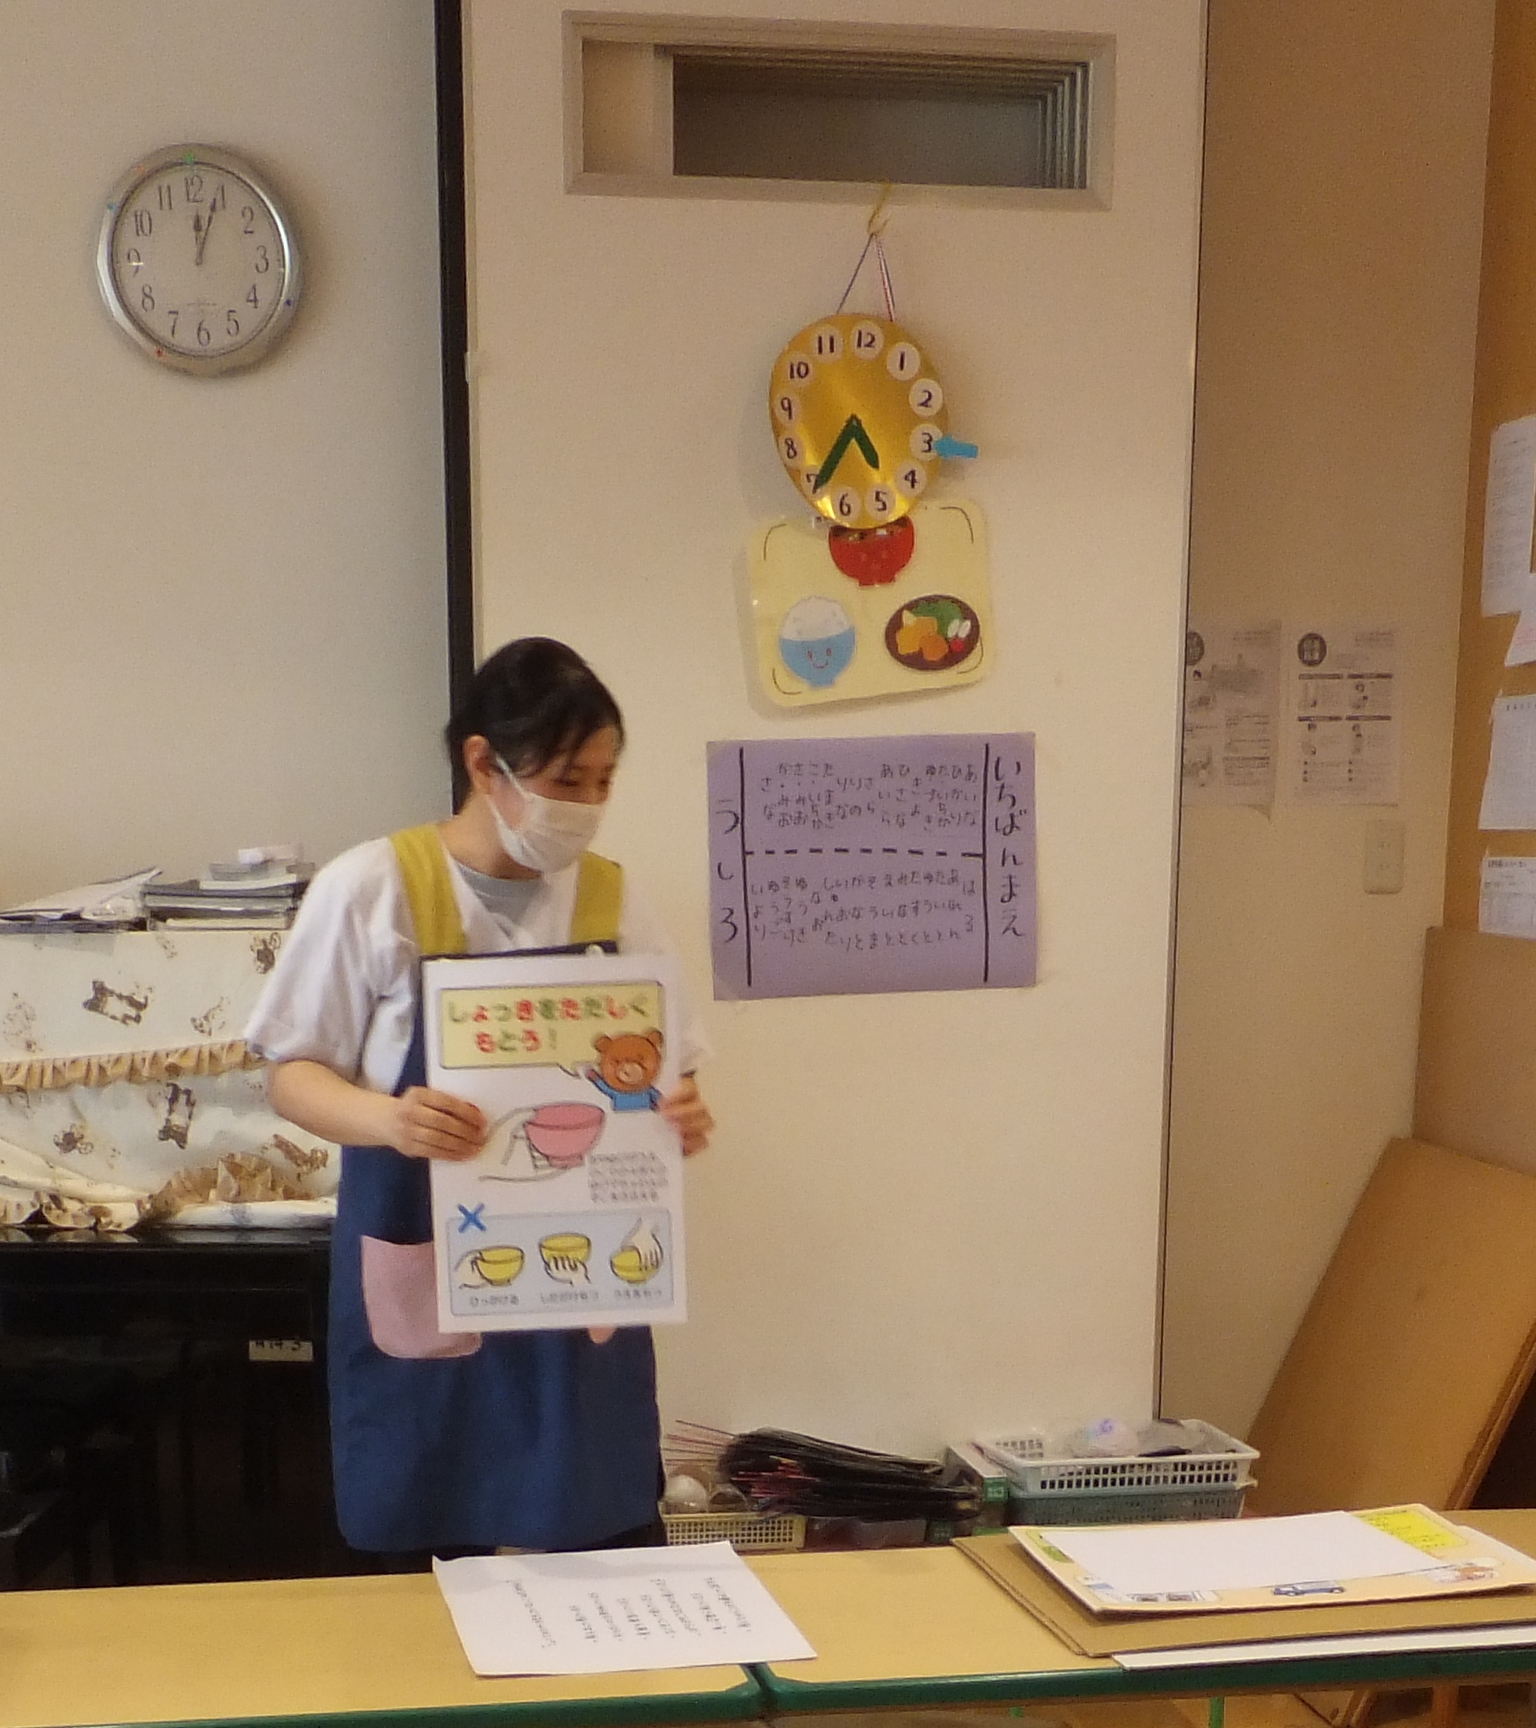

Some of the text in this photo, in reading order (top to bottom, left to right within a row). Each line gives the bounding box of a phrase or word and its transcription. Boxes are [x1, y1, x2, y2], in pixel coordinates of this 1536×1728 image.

[157, 185, 173, 211] 11
[184, 175, 204, 203] 12
[133, 210, 153, 237] 10
[241, 206, 254, 235] 2
[255, 245, 270, 274] 3
[140, 284, 155, 312] 8
[246, 284, 259, 310] 4
[167, 310, 180, 339] 7
[196, 318, 211, 347] 6
[226, 310, 240, 337] 5
[816, 334, 837, 355] 11
[855, 329, 876, 349] 12
[789, 360, 809, 380] 10
[897, 351, 906, 372] 1
[780, 396, 794, 421] 9
[917, 390, 933, 407] 2
[784, 438, 798, 460] 8
[921, 432, 934, 454] 3
[904, 468, 918, 490] 4
[838, 492, 852, 516] 6
[874, 489, 888, 512] 5
[993, 756, 1028, 938] いちばんまえ
[715, 799, 741, 943] うしろ
